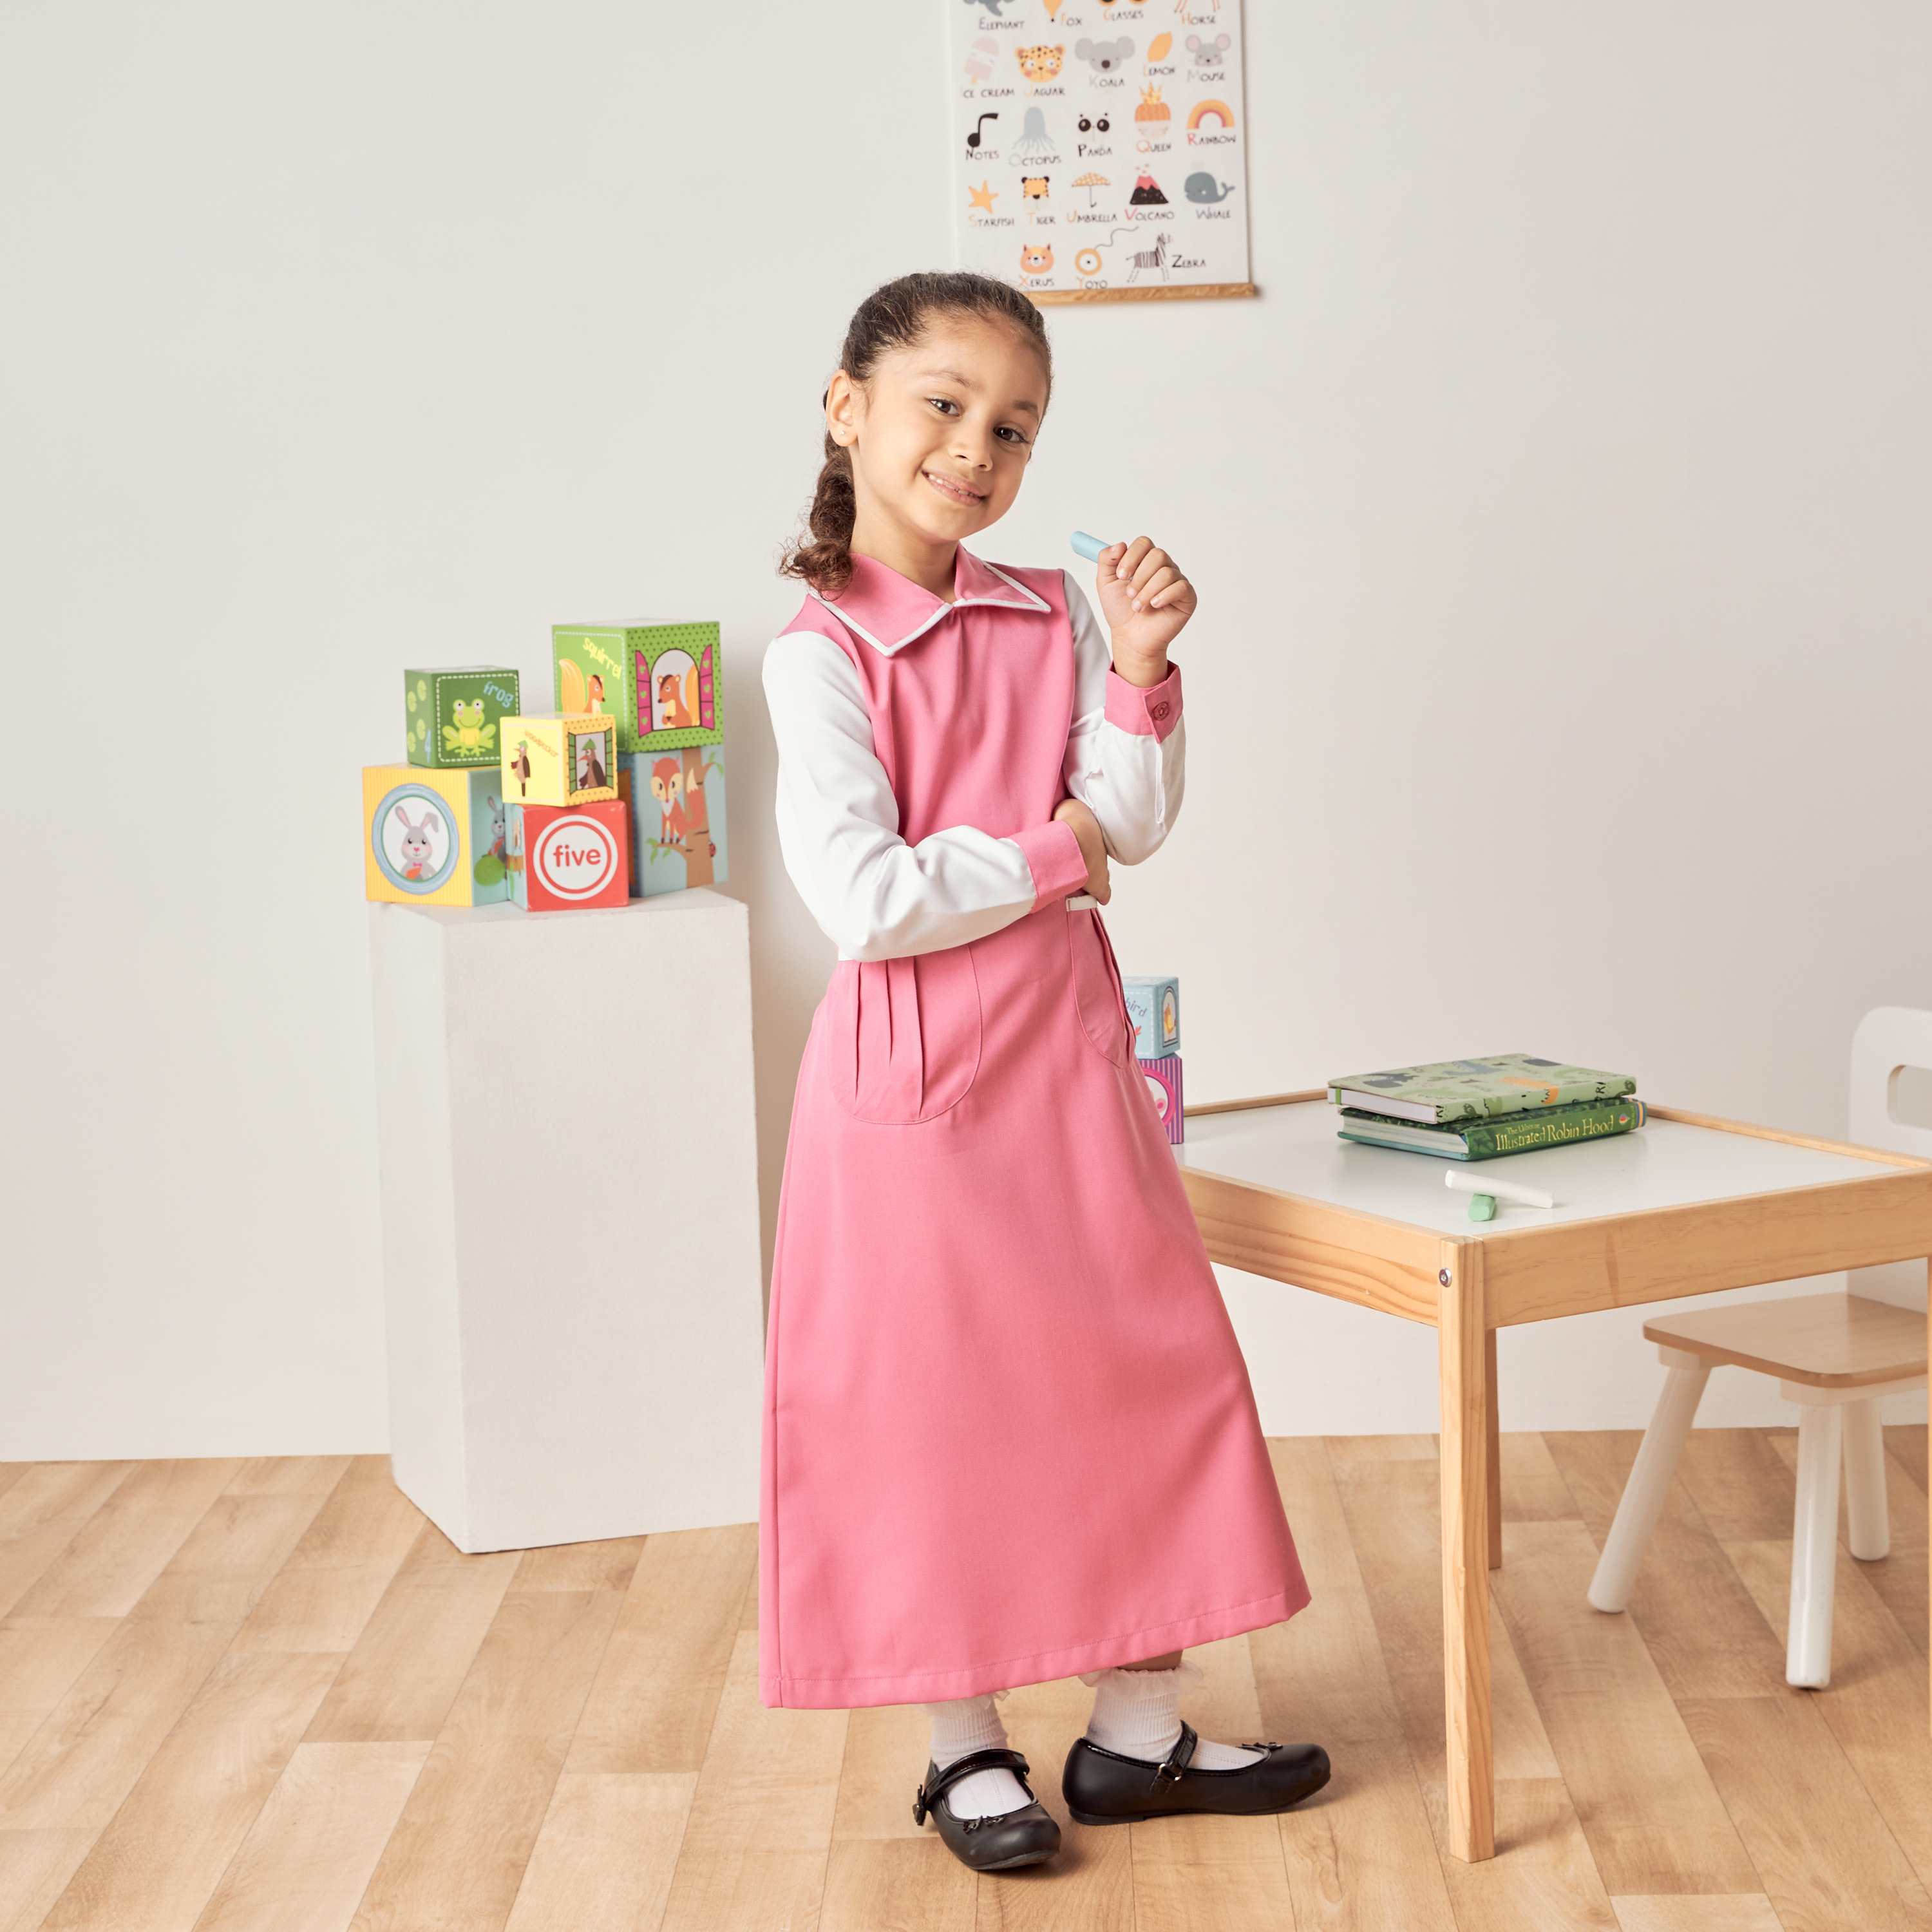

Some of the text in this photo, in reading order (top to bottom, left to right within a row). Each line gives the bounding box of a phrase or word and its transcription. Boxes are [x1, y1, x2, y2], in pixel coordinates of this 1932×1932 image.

[1060, 12, 1083, 26] FOX
[1103, 7, 1144, 21] GLASSES
[1182, 12, 1216, 25] HORSE
[979, 17, 1025, 30] ELEPHANT
[1142, 64, 1175, 77] LEMON
[1187, 70, 1225, 82] MOUSE
[1089, 73, 1125, 88] KOALA
[981, 88, 1015, 98] CREAM
[1023, 84, 1066, 97] JAGUAR
[1186, 133, 1236, 146] RAINBOW
[1077, 144, 1112, 157] PANDA
[1135, 140, 1171, 153] QUEEN
[966, 149, 999, 161] NOTES
[1009, 154, 1061, 167] OCTOPUS
[1027, 212, 1056, 225] TIGER
[1066, 210, 1117, 223] UMBRELLA
[1124, 207, 1175, 221] VOLCANO
[1195, 206, 1231, 220] WHALE
[968, 214, 1014, 228] STARFISH
[1171, 254, 1206, 268] ZEBRA
[1018, 274, 1055, 288] XERUS
[1075, 276, 1108, 290] YOYO
[583, 637, 622, 679] squirrel
[483, 681, 514, 708] frog
[553, 844, 601, 867] five
[1495, 1126, 1546, 1151] Illustrated
[1547, 1122, 1580, 1141] Robin
[1582, 1115, 1614, 1135] Hood
